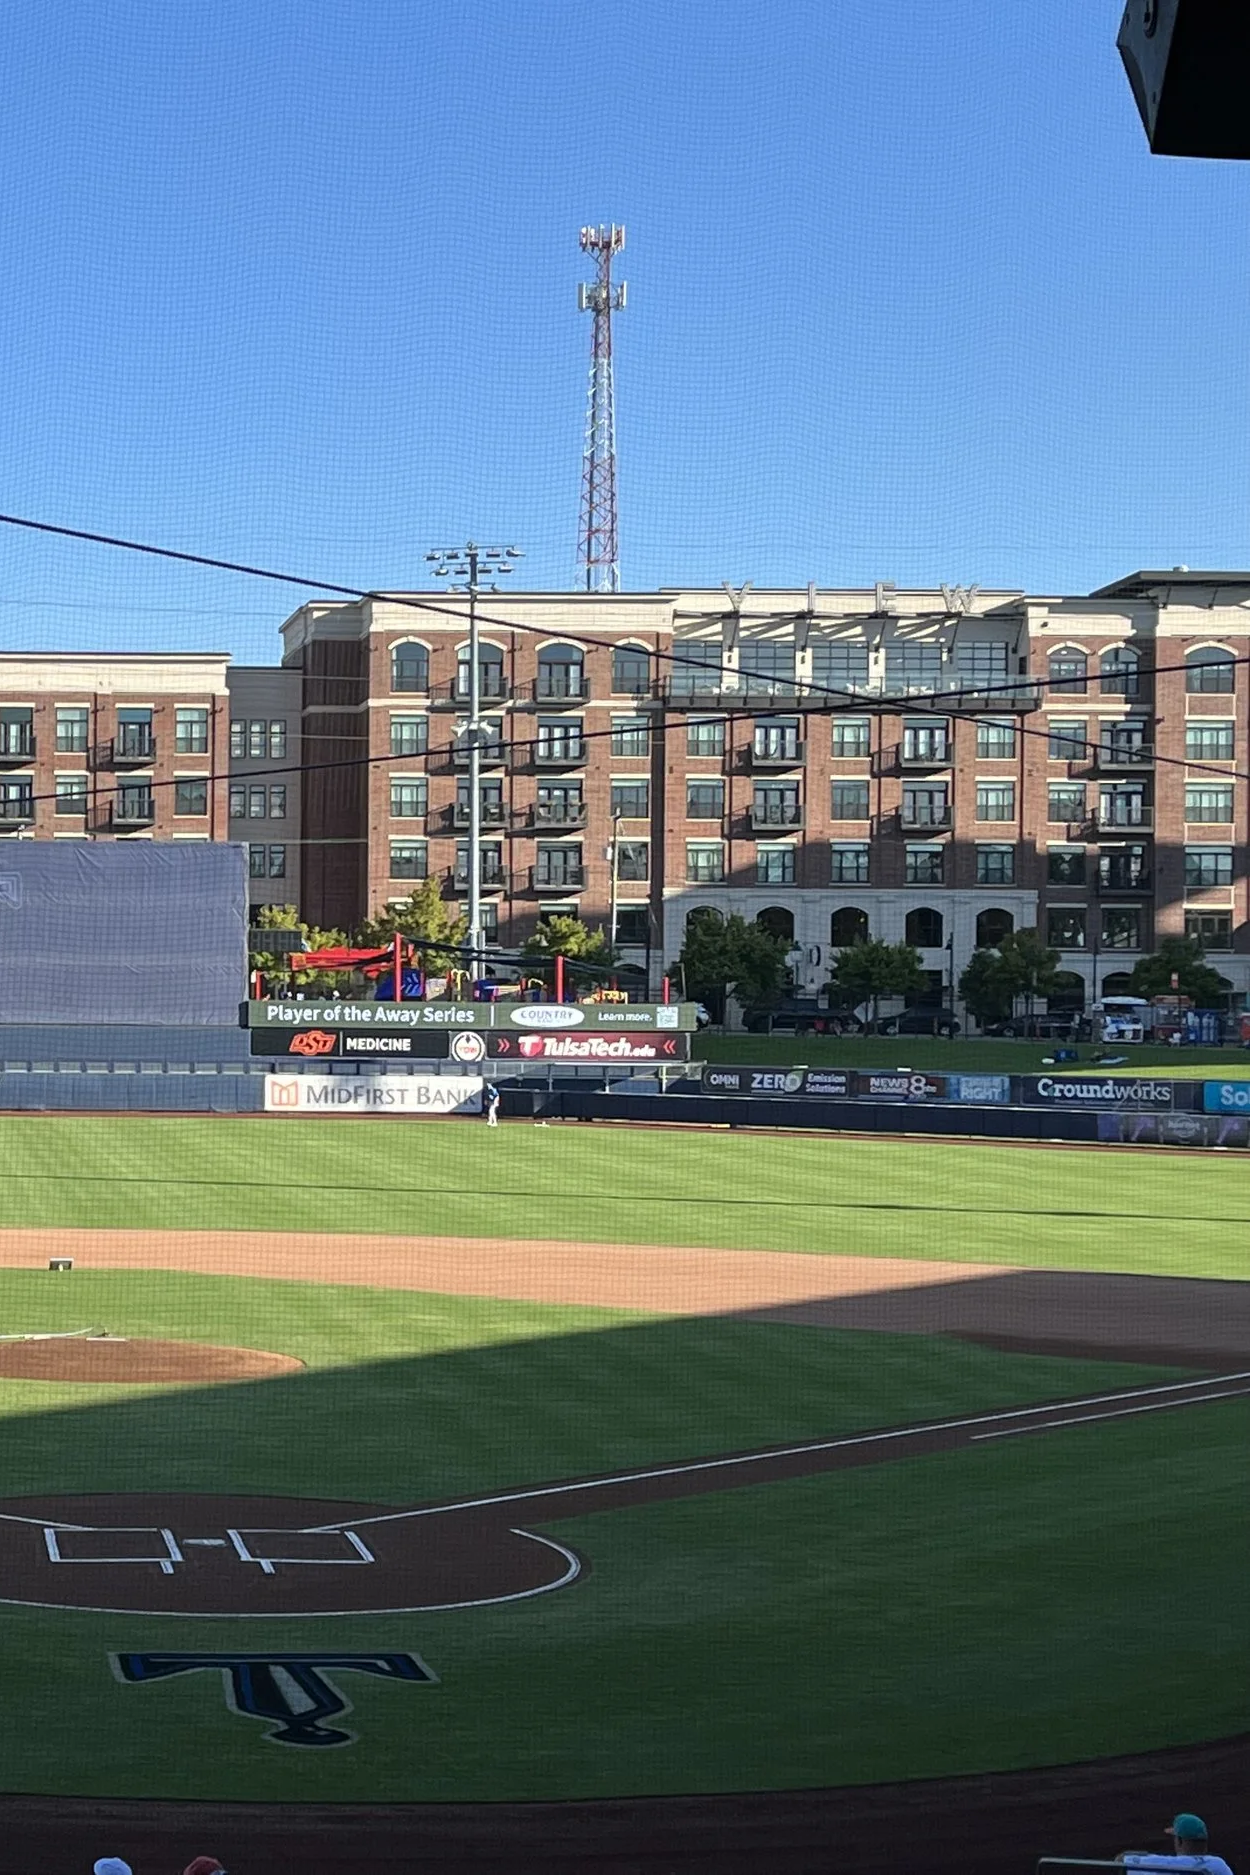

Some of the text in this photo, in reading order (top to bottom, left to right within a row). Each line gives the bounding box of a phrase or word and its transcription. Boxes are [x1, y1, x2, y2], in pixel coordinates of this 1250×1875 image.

[267, 1005, 475, 1026] Player of the Away Series
[520, 1010, 574, 1019] COUNTRY
[598, 1012, 625, 1022] Learn
[346, 1037, 412, 1051] MEDICINE
[542, 1037, 656, 1057] TulsaTech.edu
[710, 1073, 740, 1085] OMNI
[751, 1071, 800, 1092] ZERO
[807, 1072, 846, 1083] Emission
[870, 1077, 909, 1088] NEWS
[1037, 1078, 1171, 1100] Groundworks
